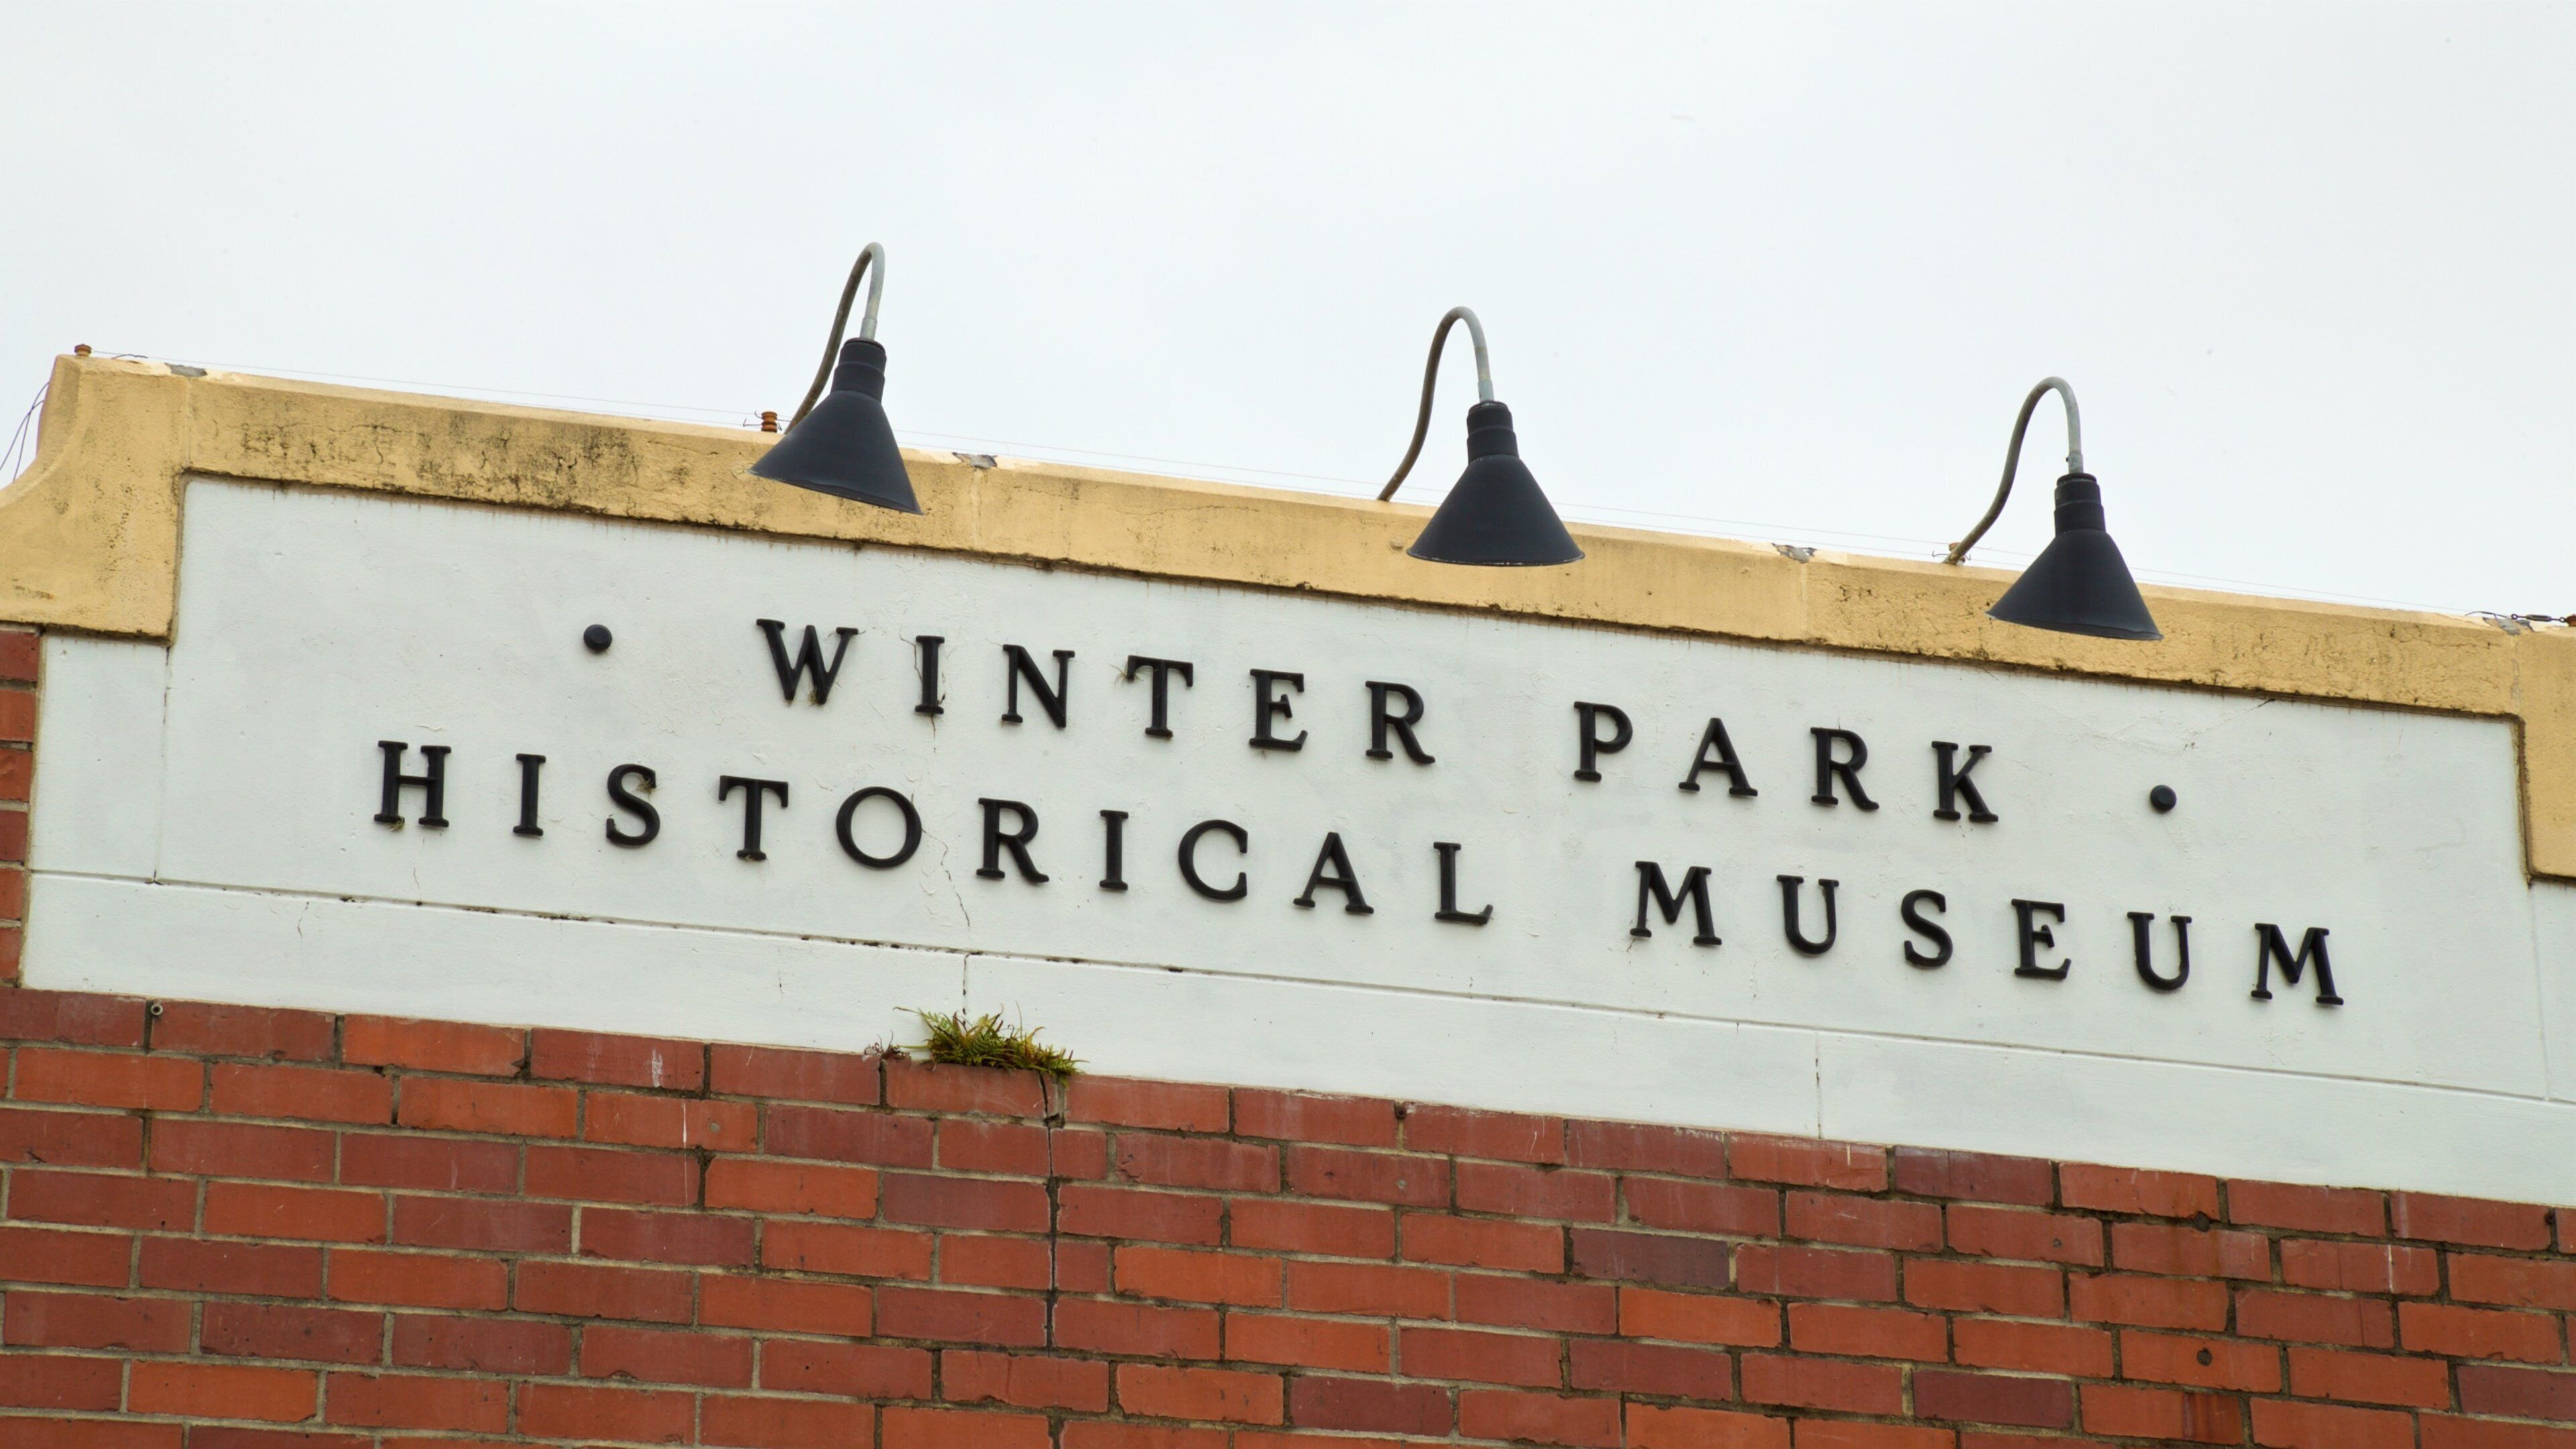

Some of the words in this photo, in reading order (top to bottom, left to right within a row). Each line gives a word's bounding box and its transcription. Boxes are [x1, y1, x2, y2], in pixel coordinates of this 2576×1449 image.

[756, 619, 1435, 767] WINTER
[1574, 702, 1998, 825] PARK
[374, 741, 1493, 927] HISTORICAL
[1630, 861, 2343, 1009] MUSEUM
